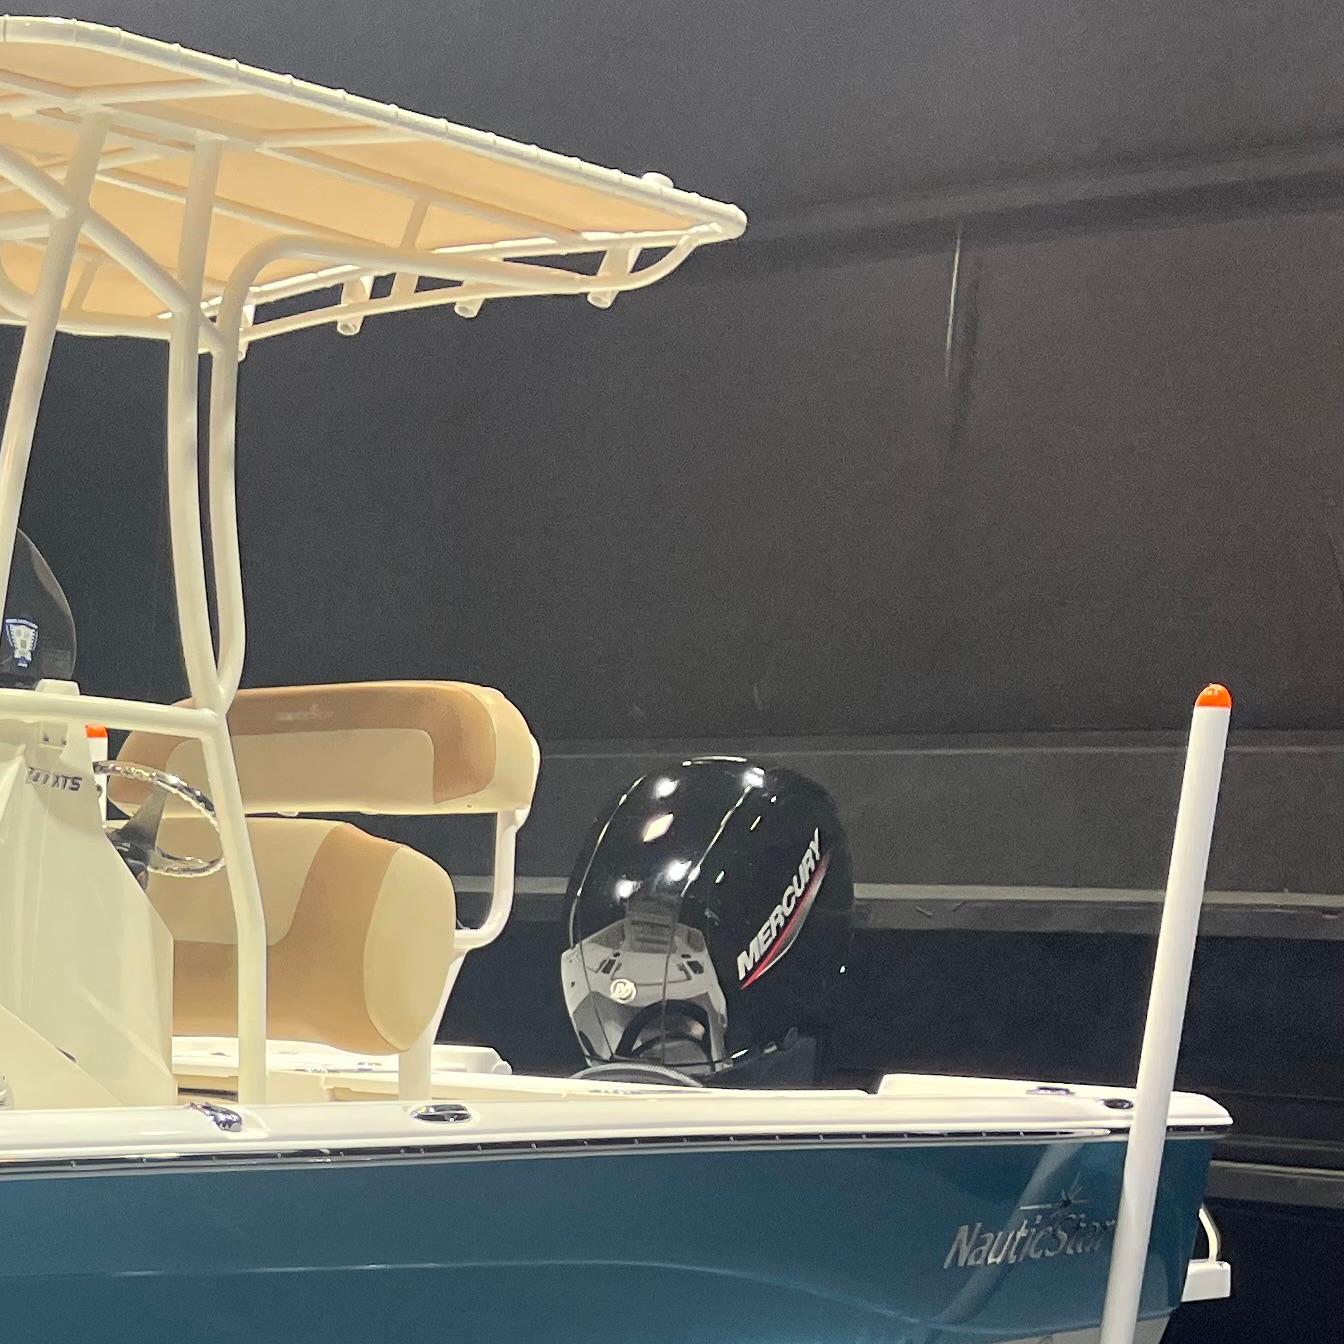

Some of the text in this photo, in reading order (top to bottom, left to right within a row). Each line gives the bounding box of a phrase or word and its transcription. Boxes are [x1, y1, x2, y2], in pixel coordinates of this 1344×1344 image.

[52, 774, 82, 791] XTS
[736, 826, 821, 981] MERCURY
[943, 1212, 1116, 1269] NauticStar
